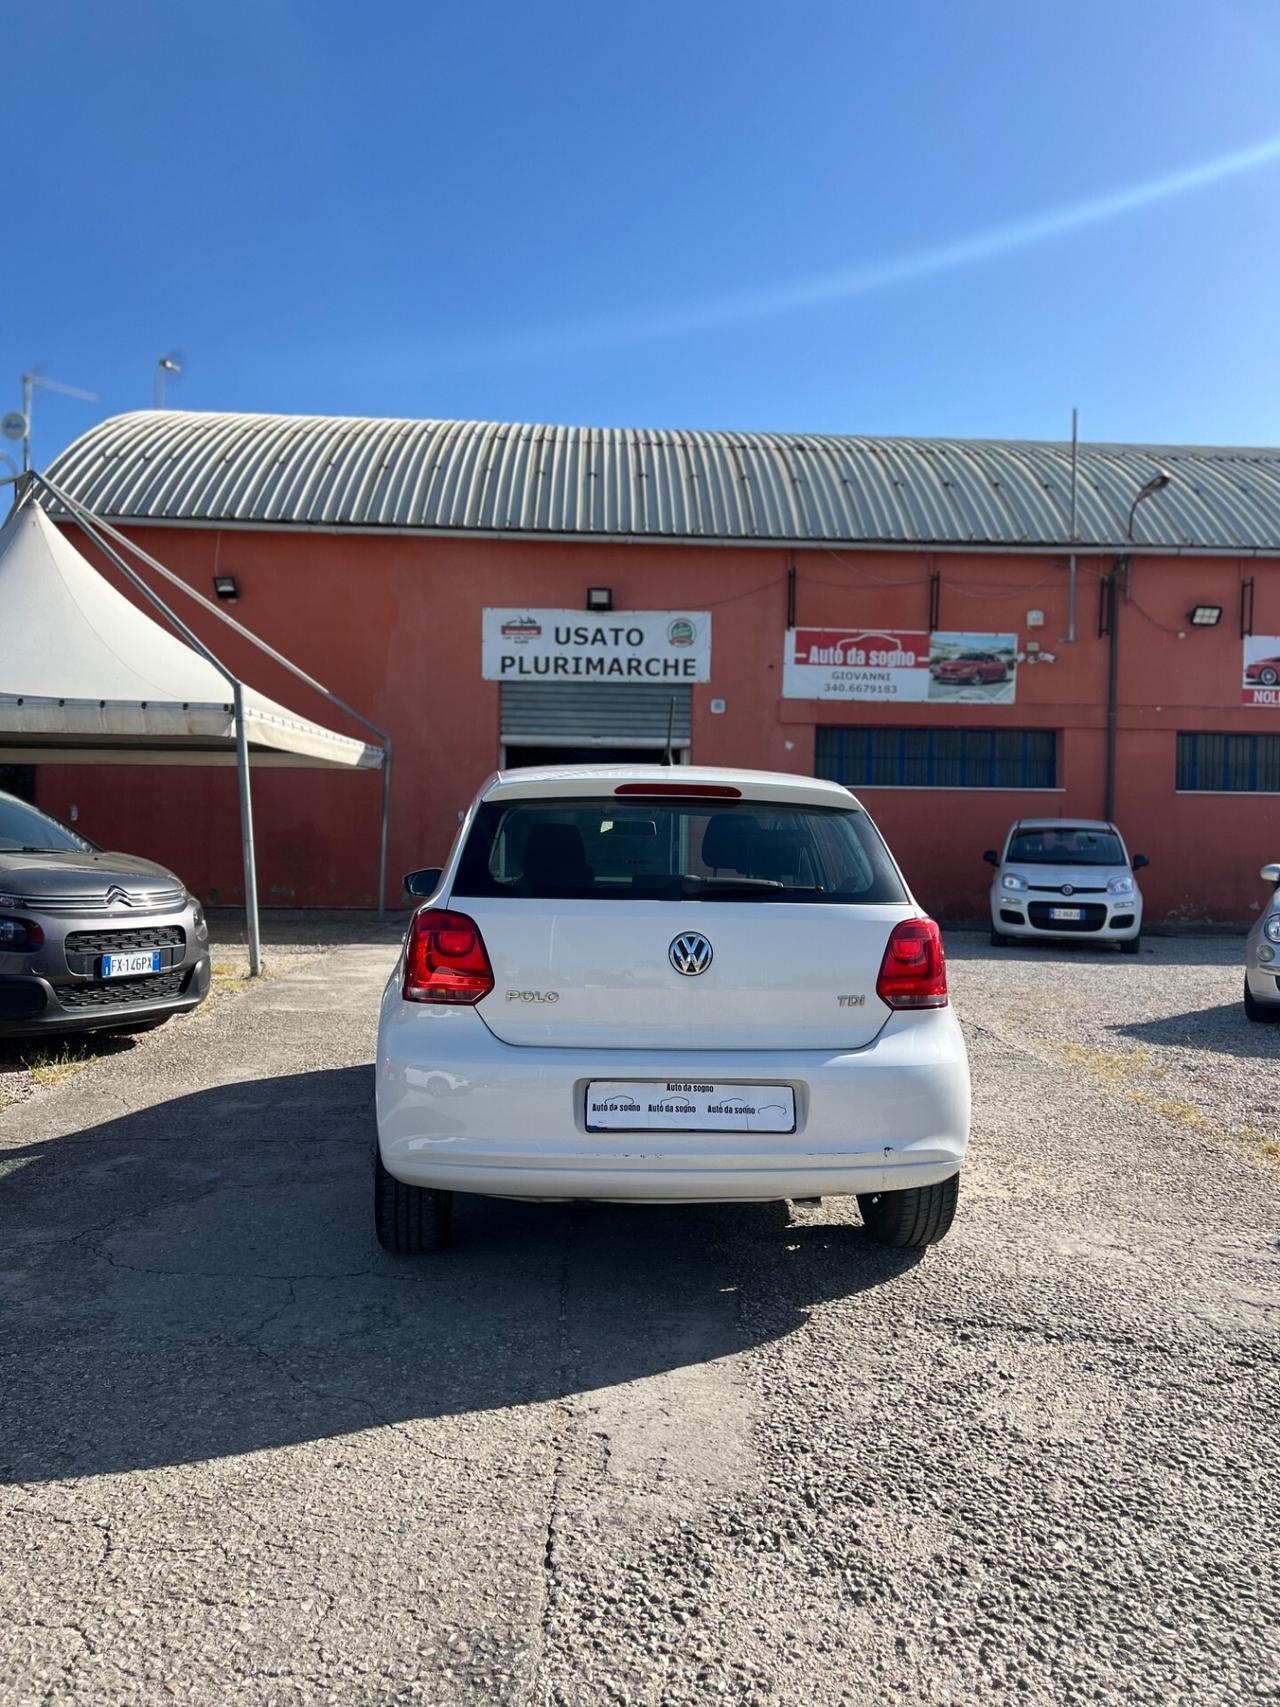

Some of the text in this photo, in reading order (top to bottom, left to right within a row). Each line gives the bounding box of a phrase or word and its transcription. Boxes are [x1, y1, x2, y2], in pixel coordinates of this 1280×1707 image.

[554, 627, 644, 646] USATO
[809, 645, 915, 669] Auto da sogno
[500, 656, 697, 677] PLURIMARCHE
[831, 671, 891, 681] GIOVANNI
[824, 683, 898, 694] 340.6679183
[1254, 690, 1280, 704] NOL
[505, 990, 560, 1003] POLO
[666, 1083, 714, 1093] Auto da sogno
[592, 1103, 608, 1112] Auto
[609, 1103, 618, 1111] da
[648, 1104, 696, 1114] Auto da sogno
[707, 1104, 723, 1113] Auto
[724, 1105, 733, 1113] da
